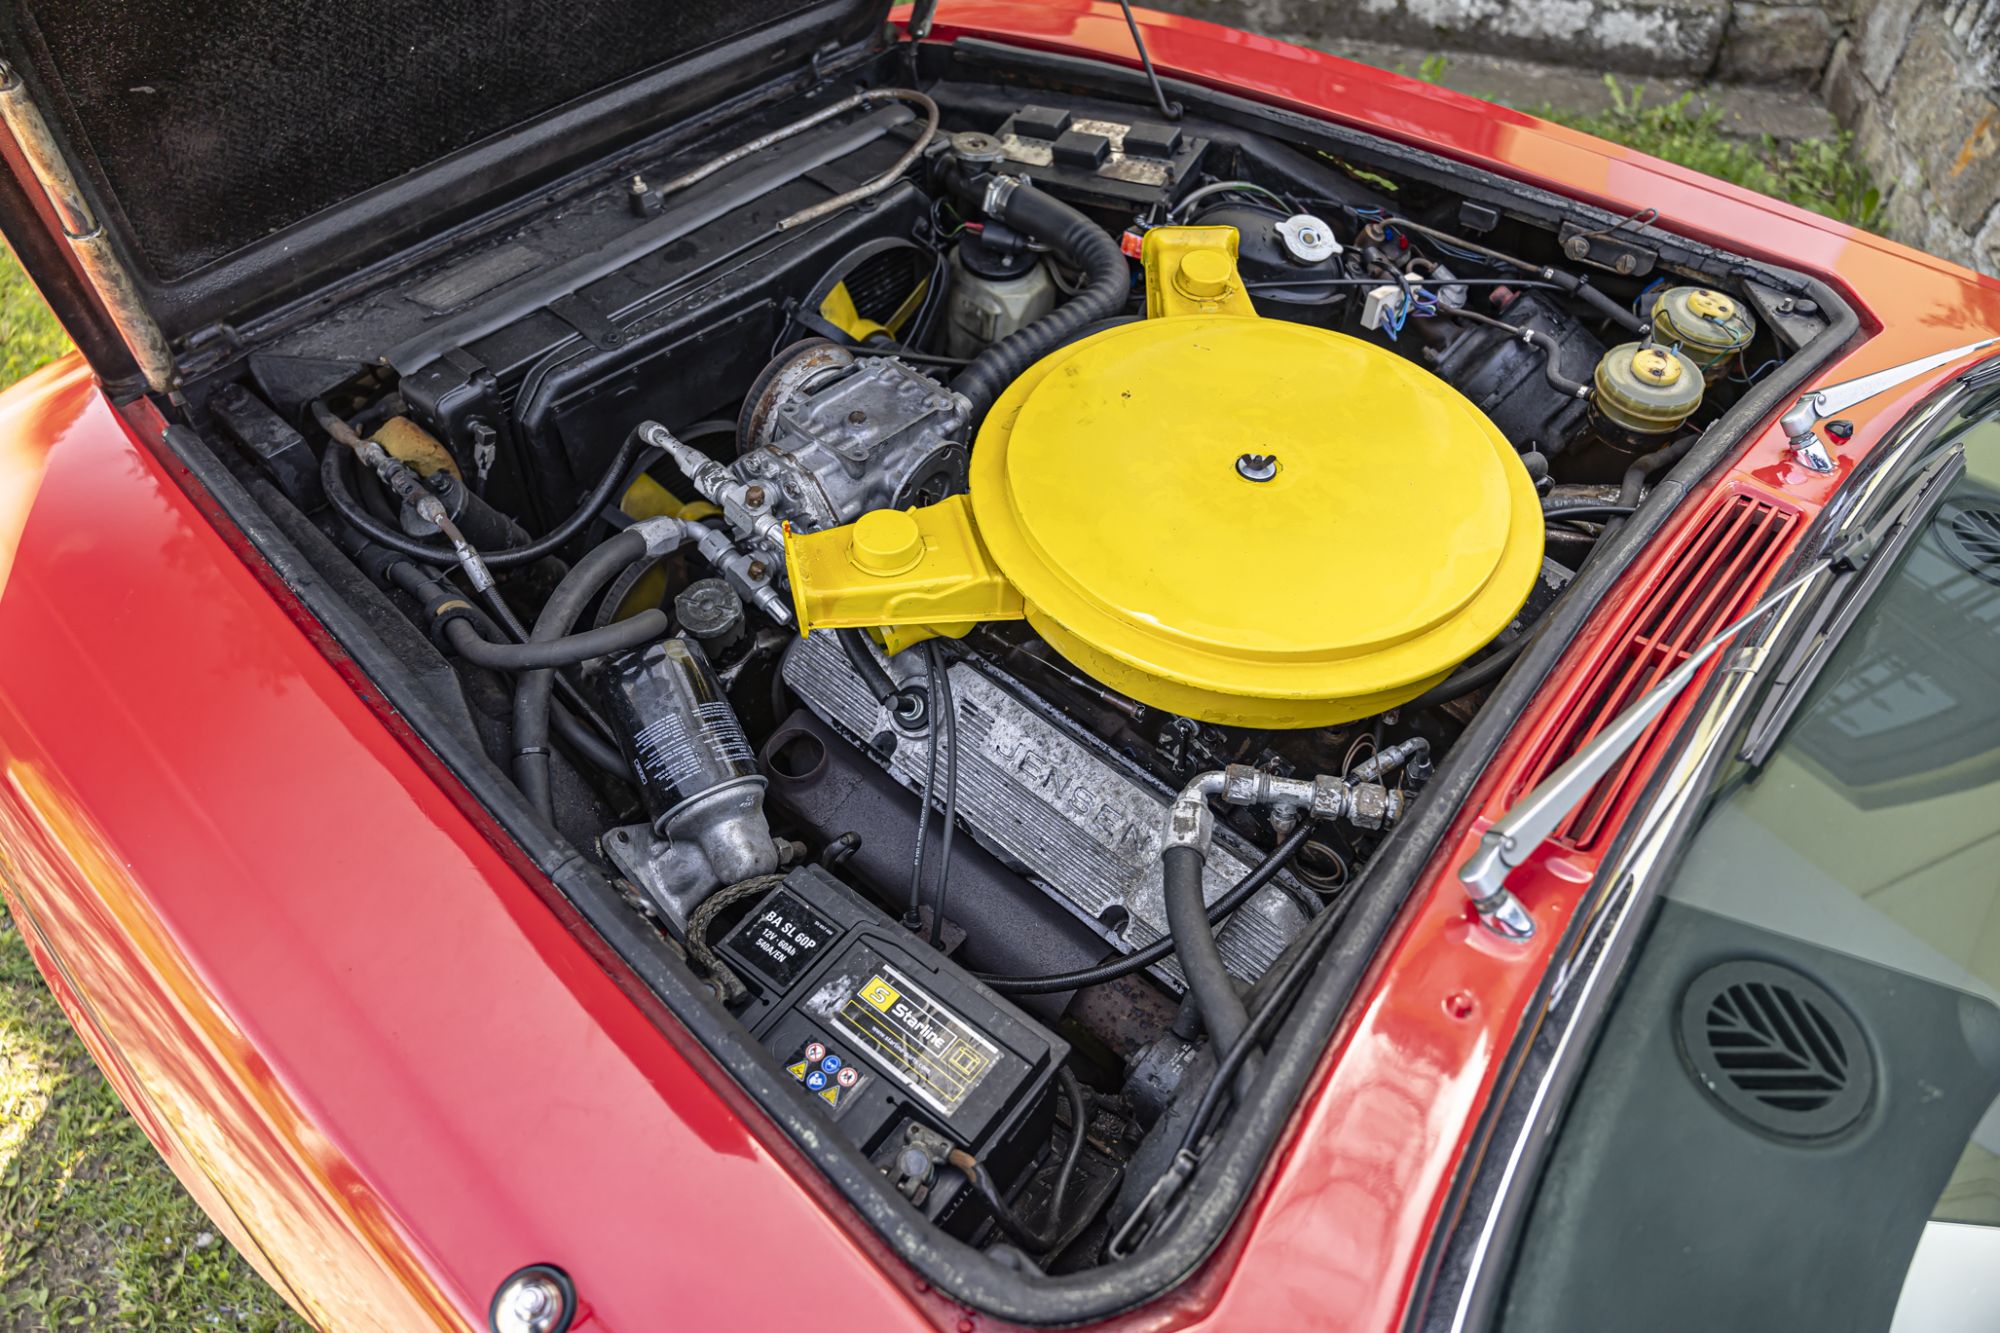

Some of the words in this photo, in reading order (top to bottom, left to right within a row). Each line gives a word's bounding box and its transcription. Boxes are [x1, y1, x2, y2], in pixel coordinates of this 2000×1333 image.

[995, 743, 1153, 854] JENSEN
[762, 928, 778, 941] 12V
[777, 939, 796, 956] 60Ah
[765, 910, 783, 928] BA
[781, 922, 797, 938] SL
[794, 932, 817, 949] 60P
[755, 938, 787, 963] 540A/EN
[891, 1002, 946, 1049] Starline
